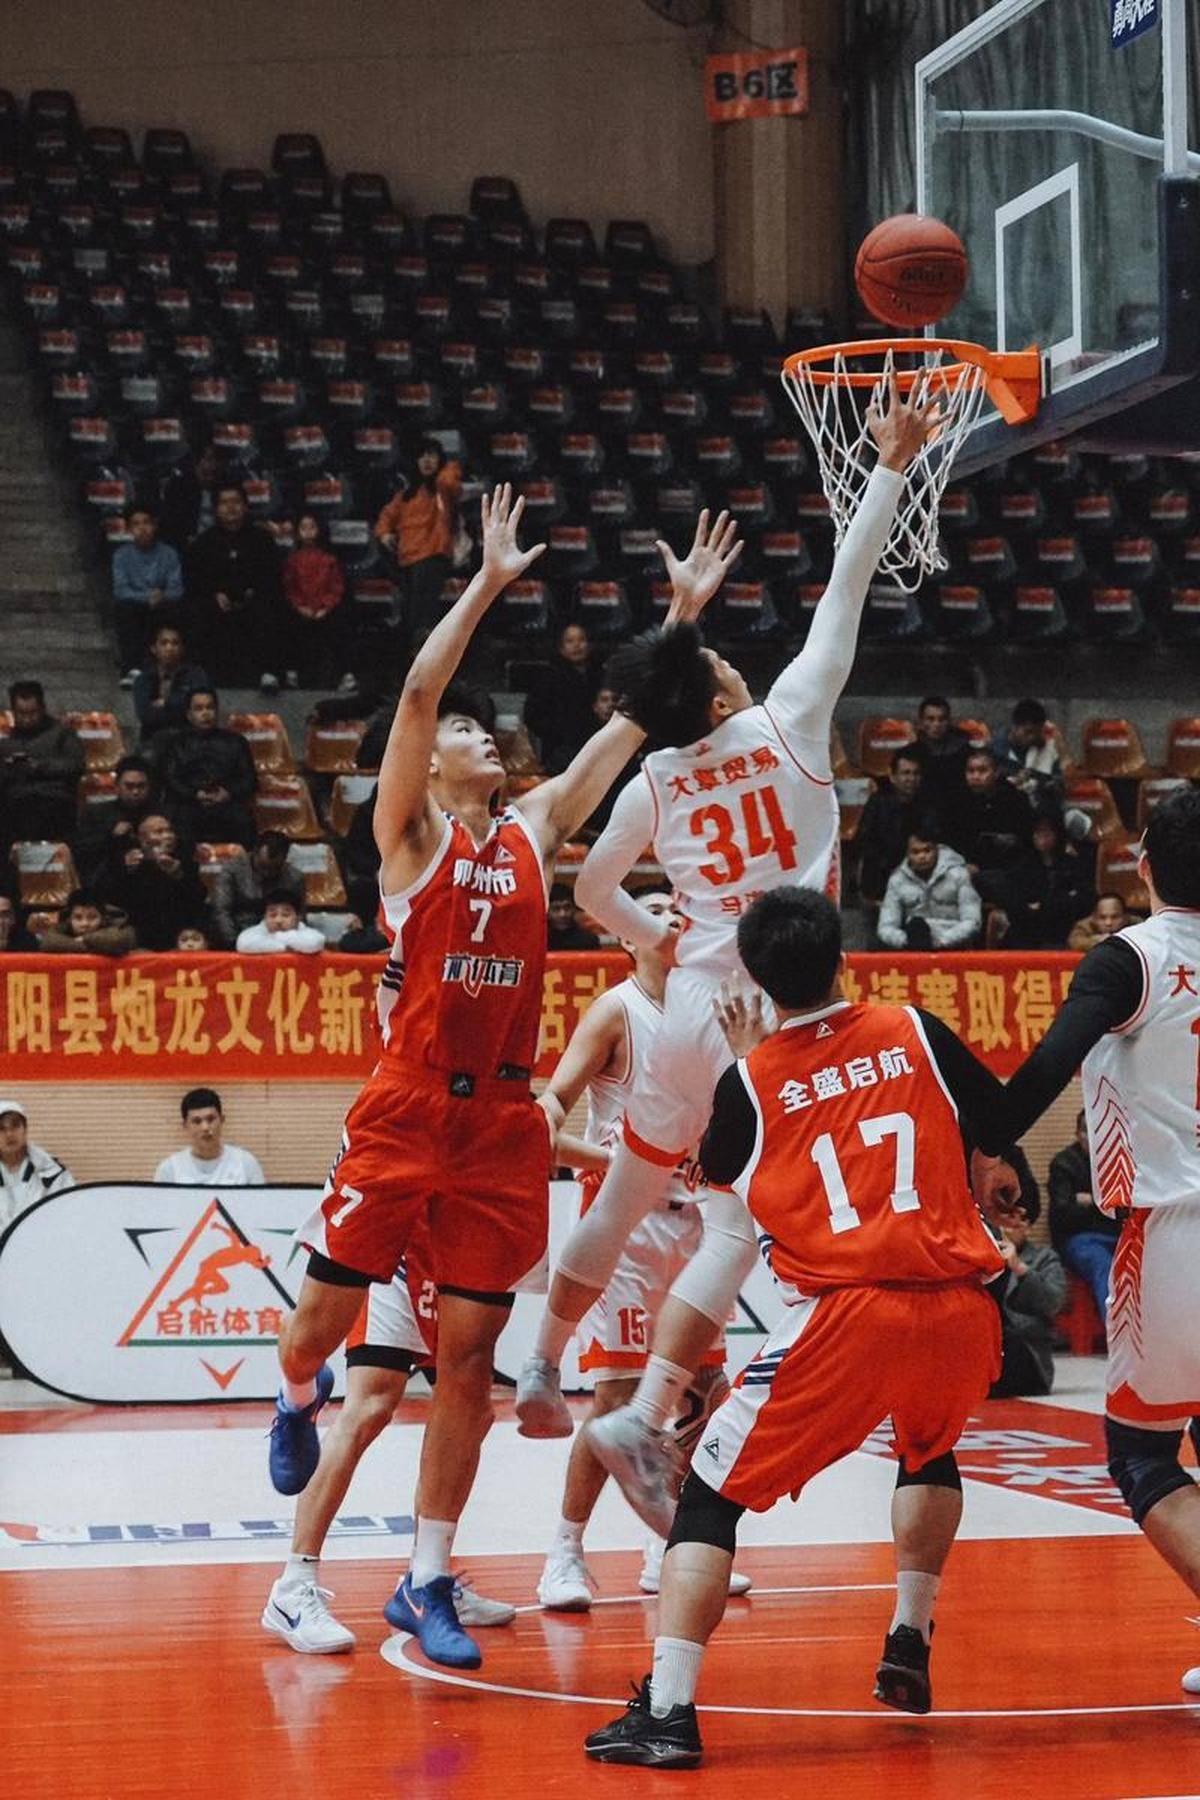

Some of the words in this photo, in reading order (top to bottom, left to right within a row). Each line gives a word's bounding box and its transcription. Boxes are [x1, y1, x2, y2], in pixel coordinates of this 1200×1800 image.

[714, 62, 798, 102] B6区
[690, 785, 797, 886] 34
[469, 899, 493, 943] 7
[6, 967, 380, 1055] 阳县炮龙文化新
[778, 1046, 914, 1114] 全盛启航
[811, 1112, 921, 1234] 17
[330, 1184, 364, 1228] 7
[157, 1306, 283, 1336] 启航体育
[617, 1307, 645, 1346] 15
